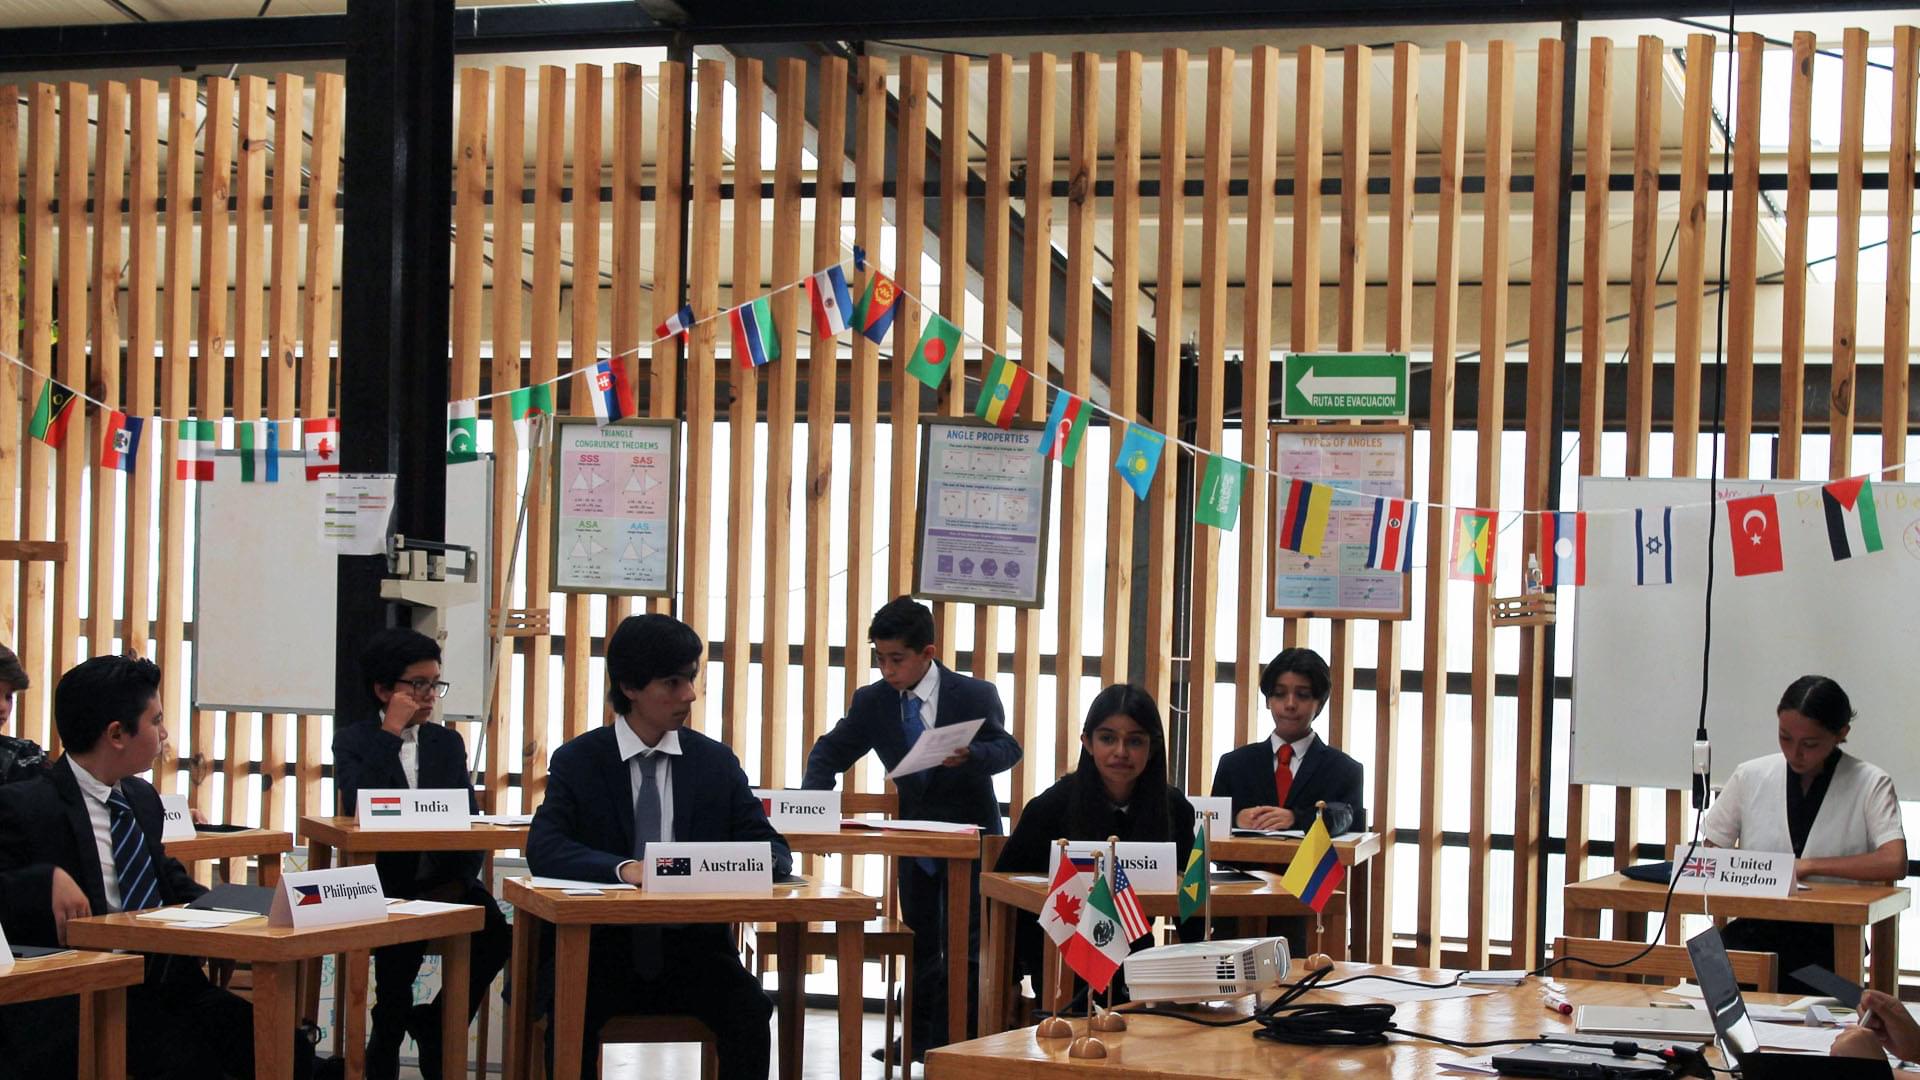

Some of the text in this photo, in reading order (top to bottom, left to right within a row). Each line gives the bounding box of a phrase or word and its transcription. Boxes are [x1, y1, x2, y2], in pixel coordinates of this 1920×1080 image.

[1312, 396, 1333, 407] RUTA
[1334, 396, 1344, 407] DE
[600, 429, 633, 438] TRIANGLE
[946, 430, 1030, 444] ANGLE PROPERTIES
[575, 440, 659, 450] CONGRUENCE THEOREMS
[1302, 437, 1331, 447] TYPES
[1333, 437, 1346, 447] OF
[580, 454, 600, 463] SSS
[632, 456, 653, 465] SAS
[578, 520, 599, 529] ASA
[630, 522, 649, 530] AAS
[414, 800, 449, 812] India
[780, 801, 826, 815] France
[164, 811, 181, 820] ico
[699, 858, 764, 872] Australia
[1114, 855, 1158, 870] ussia
[1730, 857, 1772, 871] United
[1720, 871, 1777, 886] Kingdom
[322, 881, 378, 900] Philippines
